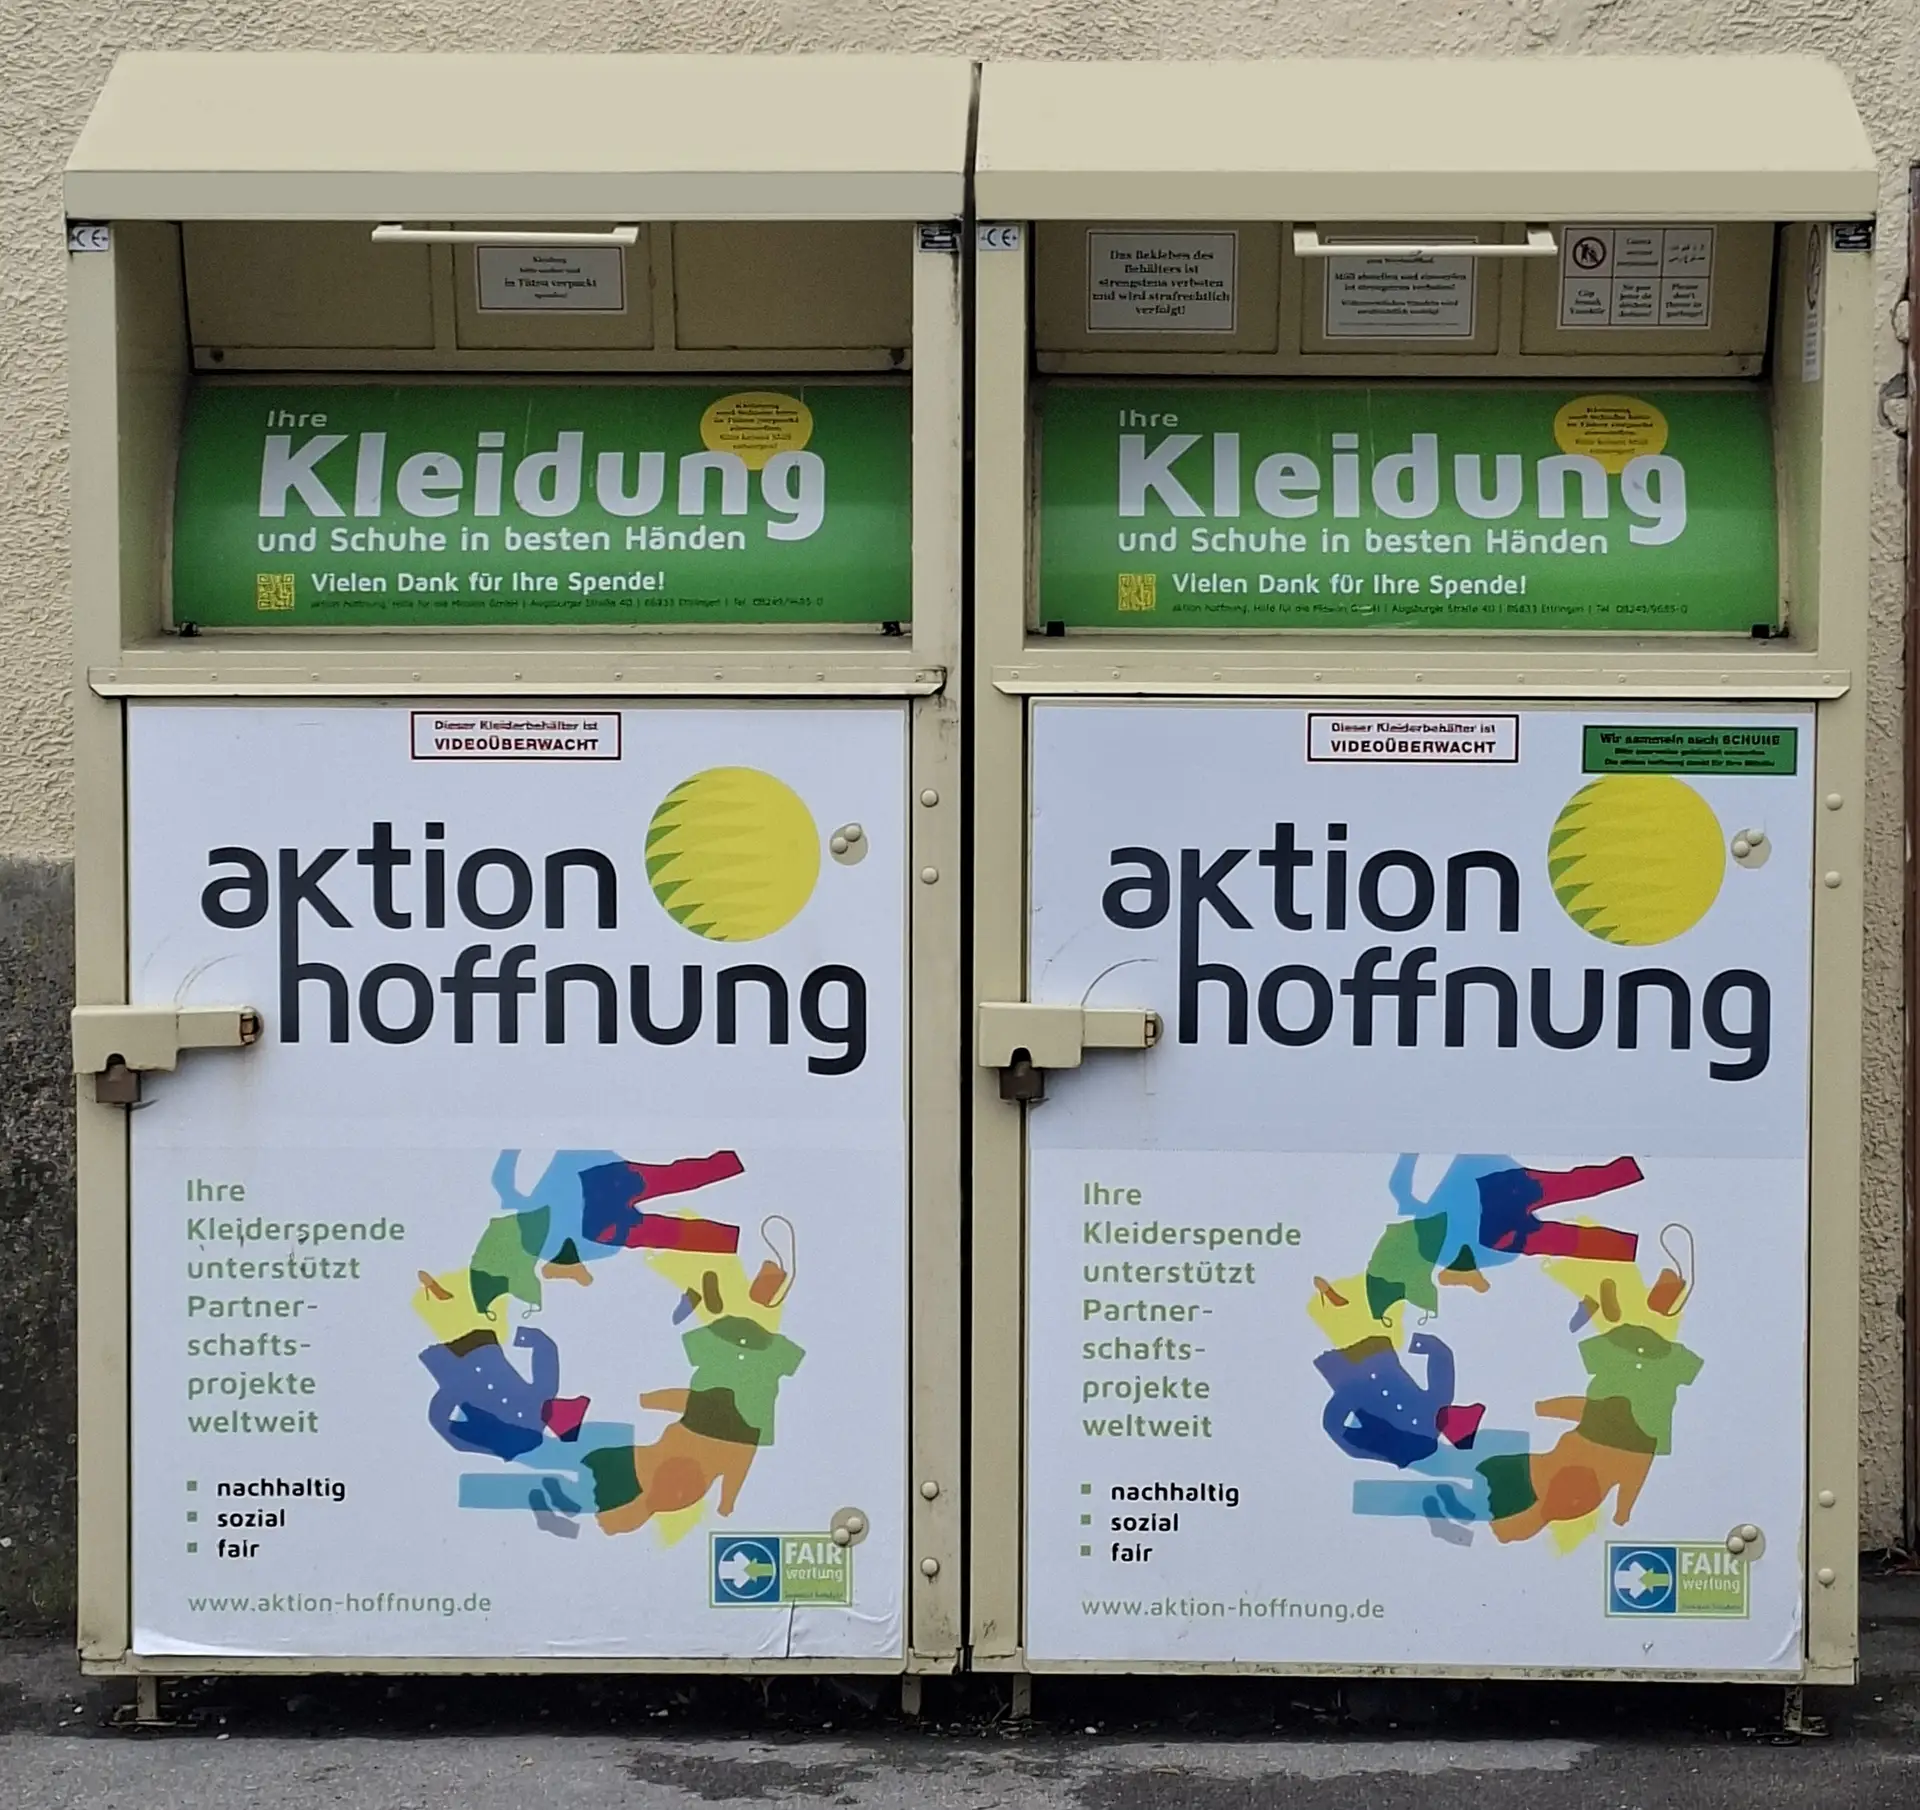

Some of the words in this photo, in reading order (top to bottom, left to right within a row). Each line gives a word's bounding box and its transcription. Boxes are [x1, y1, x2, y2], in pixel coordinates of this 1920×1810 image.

[1110, 250, 1132, 260] Das
[1136, 249, 1190, 260] Bekleben
[1193, 250, 1214, 260] des
[1125, 264, 1182, 274] Behälters
[1185, 264, 1199, 274] ist
[1099, 278, 1168, 288] strengstens
[1171, 278, 1223, 287] verboten
[1092, 291, 1115, 301] und
[1119, 291, 1146, 301] wird
[1149, 291, 1230, 302] strafrechtlich
[1135, 305, 1186, 316] verfolgt!
[266, 410, 327, 428] Ihre
[1119, 410, 1179, 428] Ihre
[258, 432, 826, 540] Kleidung
[1118, 432, 1687, 545] Kleidung
[258, 528, 316, 552] und
[331, 528, 447, 552] Schuhe
[461, 528, 489, 552] in
[505, 527, 610, 551] besten
[626, 526, 745, 550] Händen
[1118, 528, 1177, 553] und
[1191, 528, 1307, 553] Schuhe
[1321, 528, 1349, 553] in
[1365, 528, 1472, 553] besten
[1486, 528, 1608, 554] Händen
[311, 572, 386, 592] Vielen
[399, 572, 459, 592] Dank
[468, 572, 503, 592] für
[512, 572, 558, 592] Ihre
[568, 571, 665, 595] Spende!
[1172, 572, 1247, 593] Vielen
[1259, 573, 1320, 593] Dank
[1329, 573, 1363, 594] für
[1373, 574, 1420, 594] Ihre
[1429, 574, 1526, 598] Spende!
[434, 720, 476, 730] Dieser
[480, 719, 578, 731] Kleiderbehälter
[583, 720, 598, 731] ist
[1331, 722, 1373, 733] Dieser
[1377, 722, 1475, 733] Kleiderbehälter
[1480, 723, 1496, 733] ist
[434, 735, 599, 750] VIDEOÜBERWACHT
[1331, 738, 1496, 753] VIDEOÜBERWACHT
[1600, 732, 1621, 744] Wir
[1625, 733, 1684, 745] sammeln
[1687, 734, 1719, 745] auch
[1722, 734, 1780, 746] SCHUHE
[201, 822, 618, 929] aktion
[1101, 822, 1520, 932] aktion
[279, 944, 867, 1076] hoffnung
[1178, 946, 1771, 1081] hoffnung
[187, 1179, 245, 1202] Ihre
[1083, 1183, 1142, 1205] Ihre
[187, 1217, 405, 1246] Kleiderspende
[1083, 1221, 1301, 1250] Kleiderspende
[187, 1255, 360, 1279] unterstützt
[1083, 1260, 1256, 1284] unterstützt
[188, 1295, 318, 1318] Partner-
[1083, 1299, 1213, 1322] Partner-
[188, 1333, 311, 1356] schafts-
[1083, 1337, 1206, 1360] schafts-
[187, 1372, 316, 1400] projekte
[1083, 1376, 1210, 1403] projekte
[188, 1410, 319, 1433] weltweit
[1083, 1414, 1212, 1438] weltweit
[217, 1478, 346, 1502] nachhaltig
[1111, 1482, 1240, 1506] nachhaltig
[217, 1508, 285, 1528] sozial
[1111, 1513, 1179, 1532] sozial
[217, 1539, 260, 1558] fair
[785, 1542, 843, 1565] FAIR
[1111, 1543, 1153, 1562] fair
[785, 1567, 843, 1583] wertung
[1682, 1578, 1740, 1593] wertung
[189, 1593, 492, 1617] www.aktion-hoffnung.de
[1082, 1598, 1384, 1622] www.aktion-hoffnung.de
